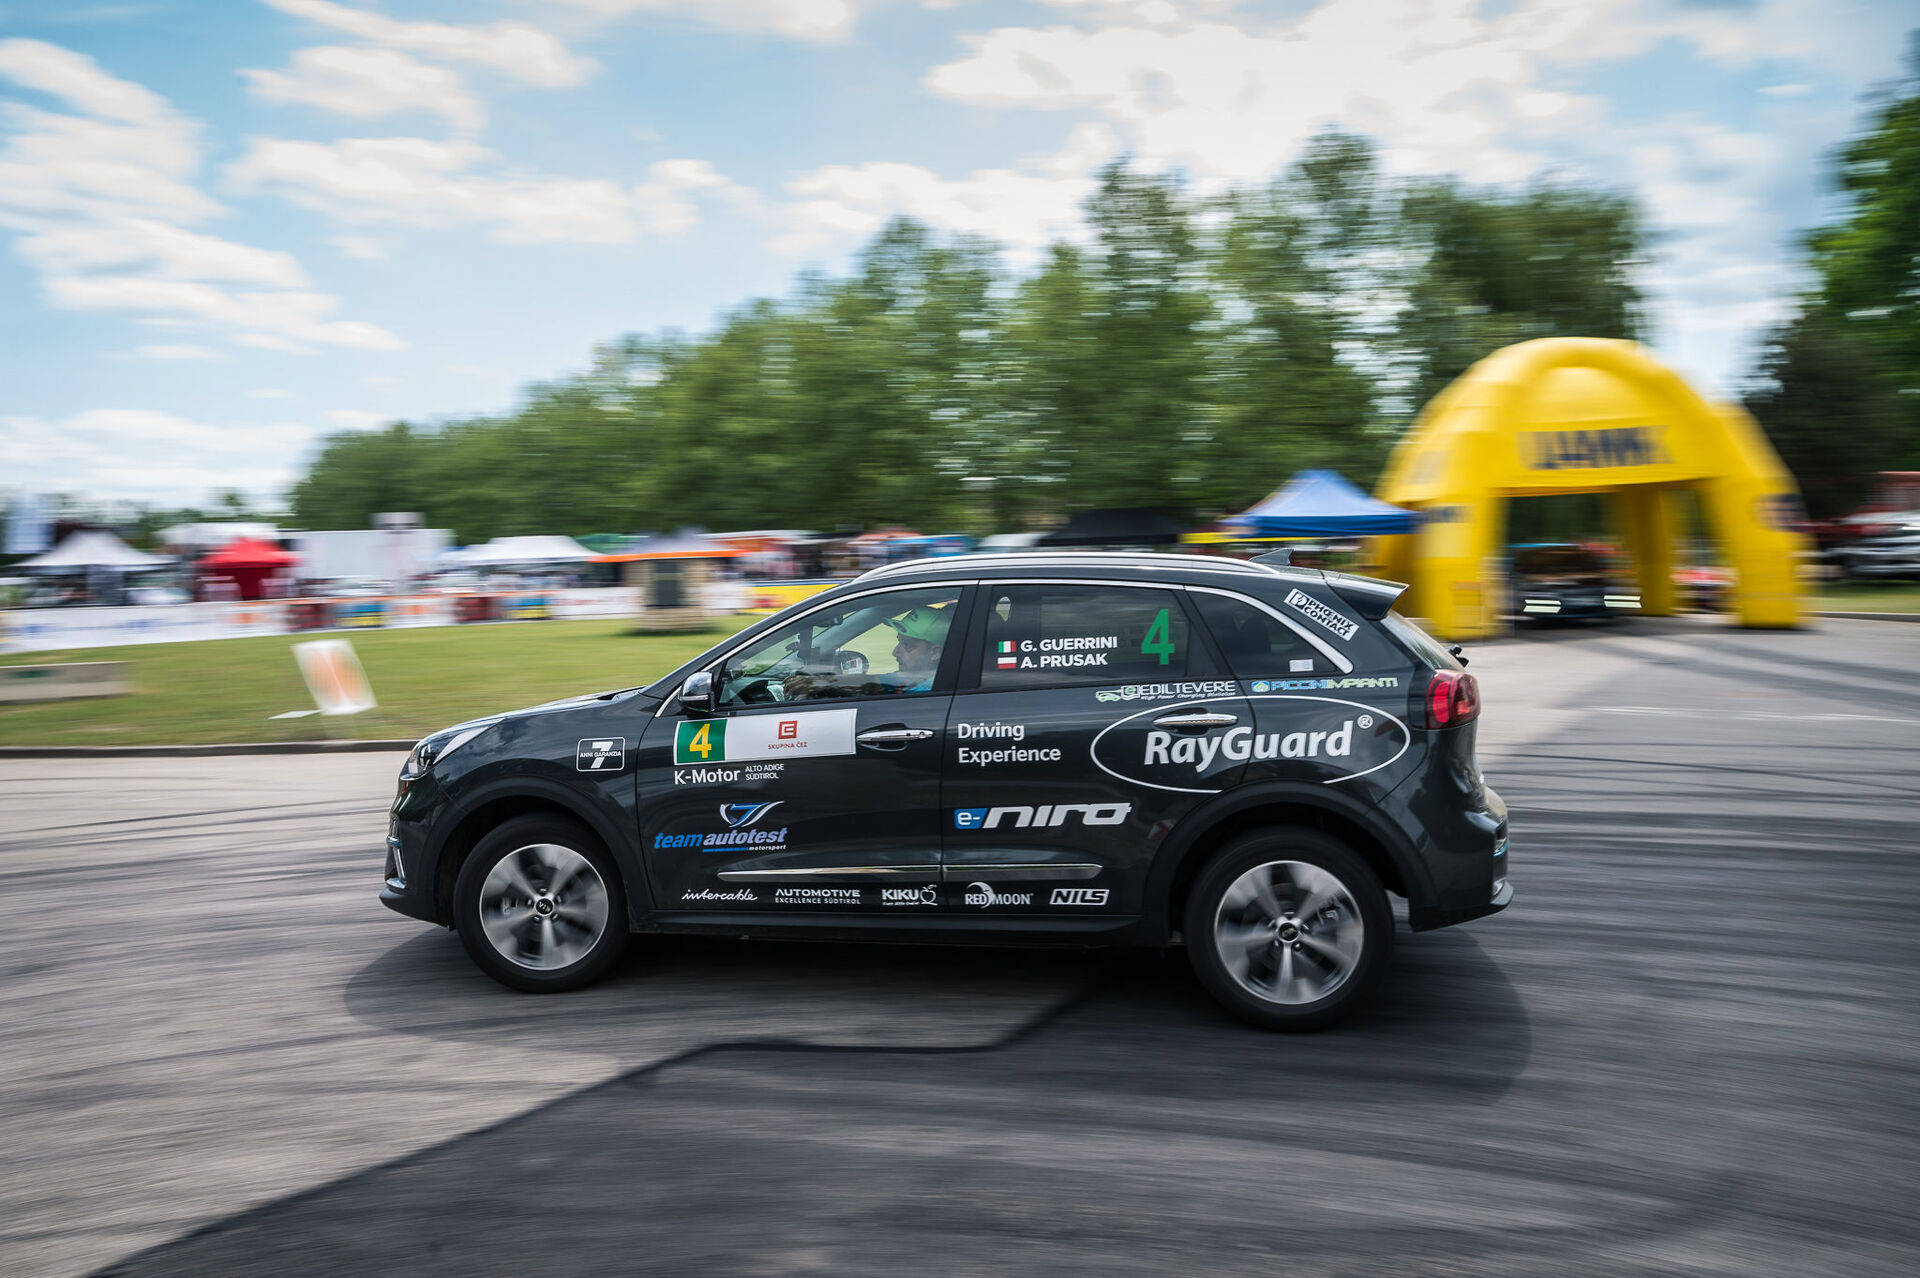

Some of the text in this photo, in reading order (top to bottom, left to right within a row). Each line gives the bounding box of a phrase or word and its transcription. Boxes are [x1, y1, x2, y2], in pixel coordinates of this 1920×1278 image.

[1304, 606, 1350, 636] CONTACT
[1020, 636, 1118, 652] G. GUERRINI
[1141, 609, 1175, 665] 4
[1020, 653, 1108, 669] A. PRUSAK
[1140, 680, 1236, 695] EDILTEVERE
[957, 723, 1024, 740] Driving
[690, 724, 712, 758] 4
[958, 747, 1061, 766] Experience
[764, 763, 784, 771] ADIGE
[674, 769, 740, 784] K-Motor
[745, 772, 779, 780] SÜDTIROL
[681, 888, 758, 900] intercable
[775, 888, 861, 897] AUTOMOTIVE
[882, 889, 919, 900] KIKU
[1052, 891, 1107, 904] NILS
